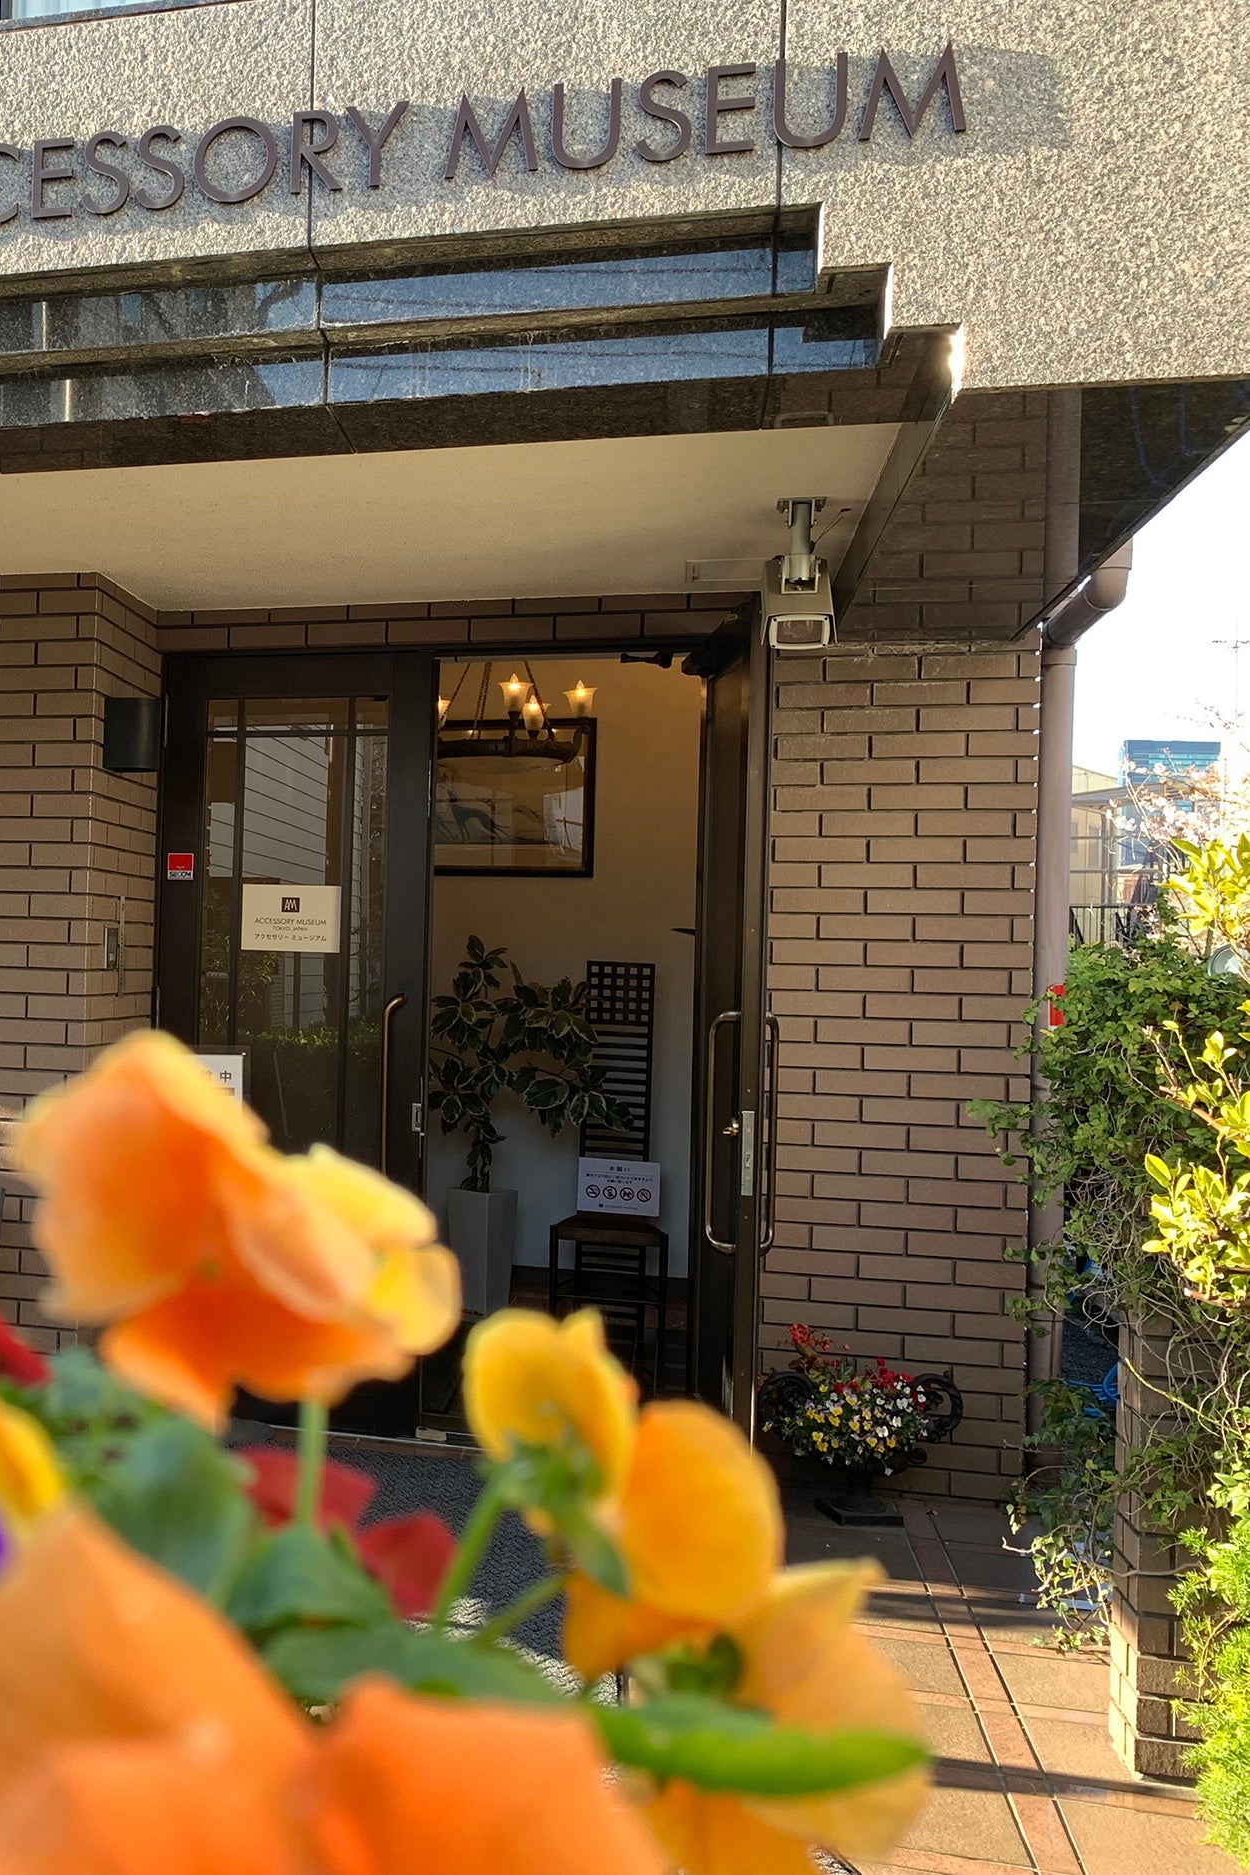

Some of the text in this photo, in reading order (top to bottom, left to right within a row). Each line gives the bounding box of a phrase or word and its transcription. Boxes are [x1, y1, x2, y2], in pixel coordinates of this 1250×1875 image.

[444, 41, 966, 179] MUSEUM
[254, 917, 327, 926] ACCESSORY MUSEUM
[291, 934, 327, 942] ミュージアム
